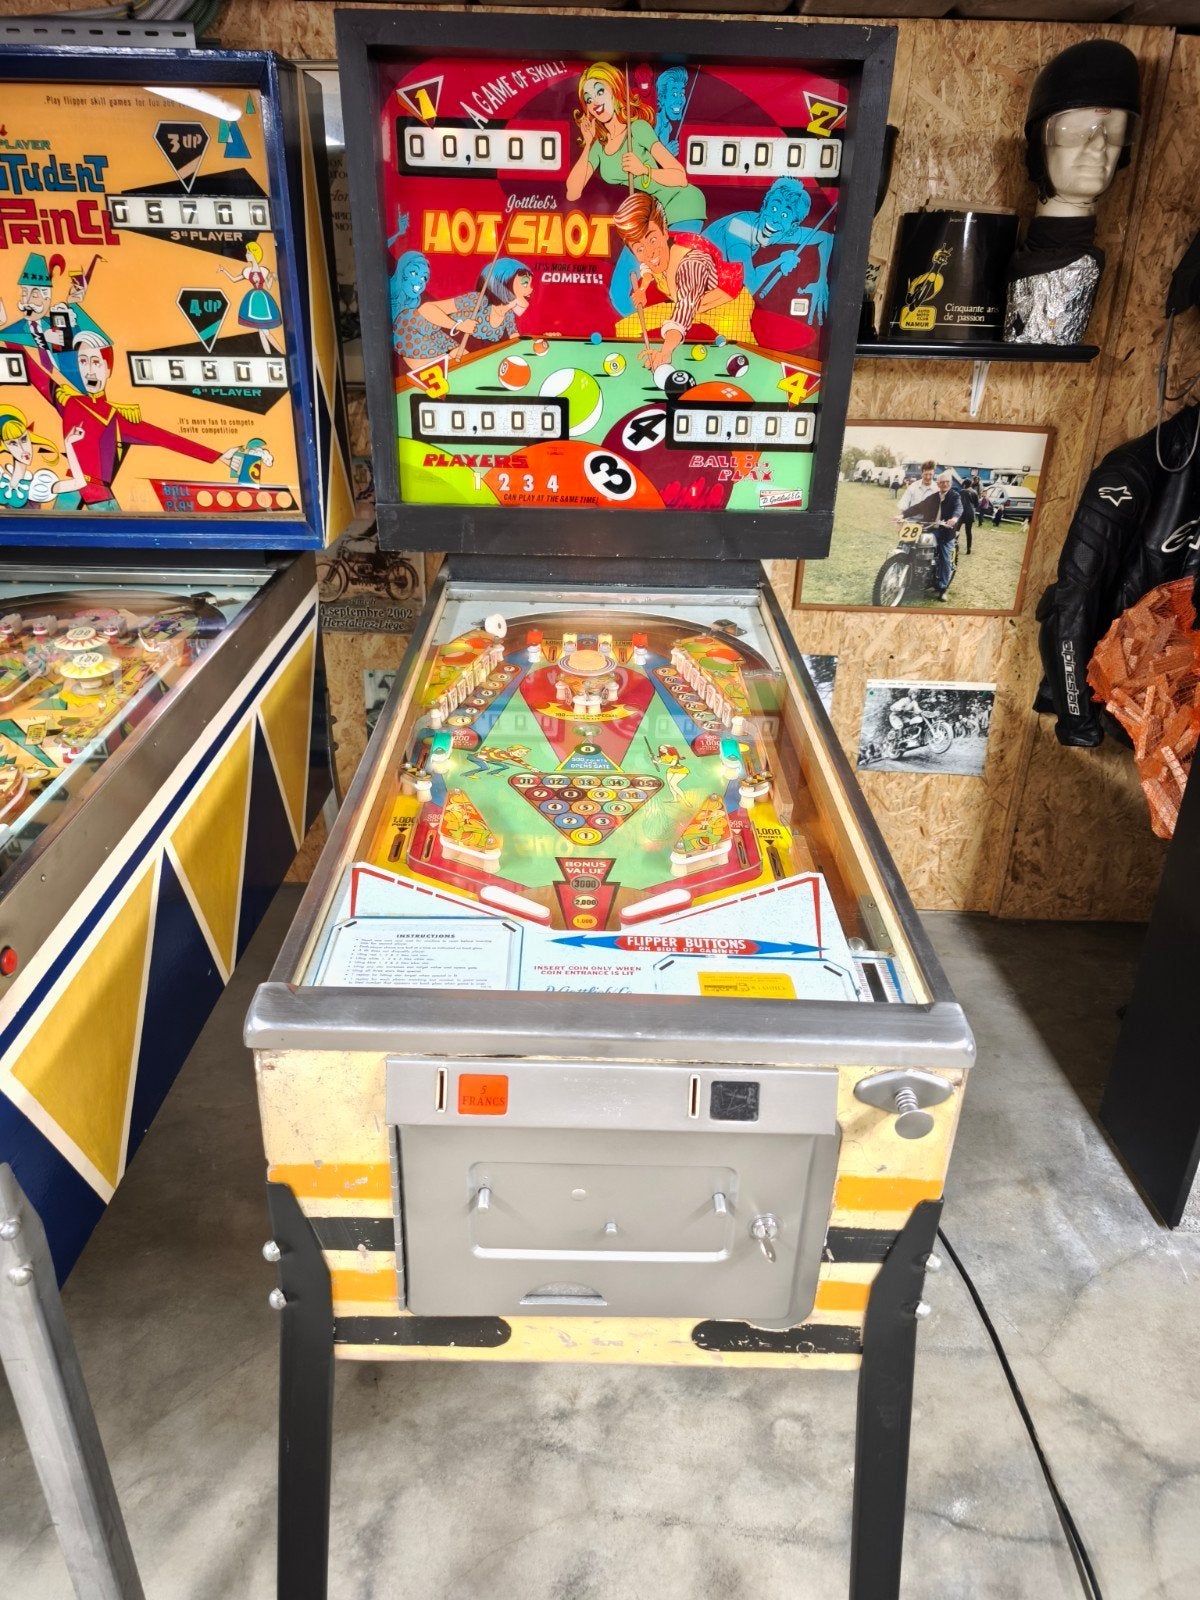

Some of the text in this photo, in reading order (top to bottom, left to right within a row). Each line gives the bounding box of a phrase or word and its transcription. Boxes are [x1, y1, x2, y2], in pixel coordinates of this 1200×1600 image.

[460, 60, 568, 131] A GAME OF SKILL!
[415, 88, 437, 119] 1
[807, 102, 839, 137] 2
[167, 133, 181, 153] 3
[505, 194, 558, 213] Gottlieb's
[190, 231, 243, 241] PLAYER
[423, 208, 616, 257] HOT SHOT
[541, 271, 604, 284] COMPETE!
[190, 299, 202, 316] 4
[945, 303, 984, 313] Cinquante
[944, 313, 985, 322] de passion
[419, 365, 450, 398] 3
[777, 371, 809, 405] 4
[210, 388, 262, 396] PLAYER
[229, 419, 254, 427] compete
[627, 413, 667, 446] 4
[202, 427, 238, 435] competition
[423, 454, 529, 469] PLAYERS
[689, 455, 738, 467] BALL
[590, 455, 632, 494] 3
[718, 470, 773, 481] PLAY
[473, 472, 559, 492] 1 2 3 4
[902, 526, 919, 538] 28
[329, 606, 384, 618] septembre
[387, 607, 413, 619] 2002
[1062, 640, 1080, 716] alpinestars
[627, 936, 747, 950] FLIPPER BUTTONS
[480, 1085, 487, 1094] 5
[462, 1095, 506, 1106] FRANCS
